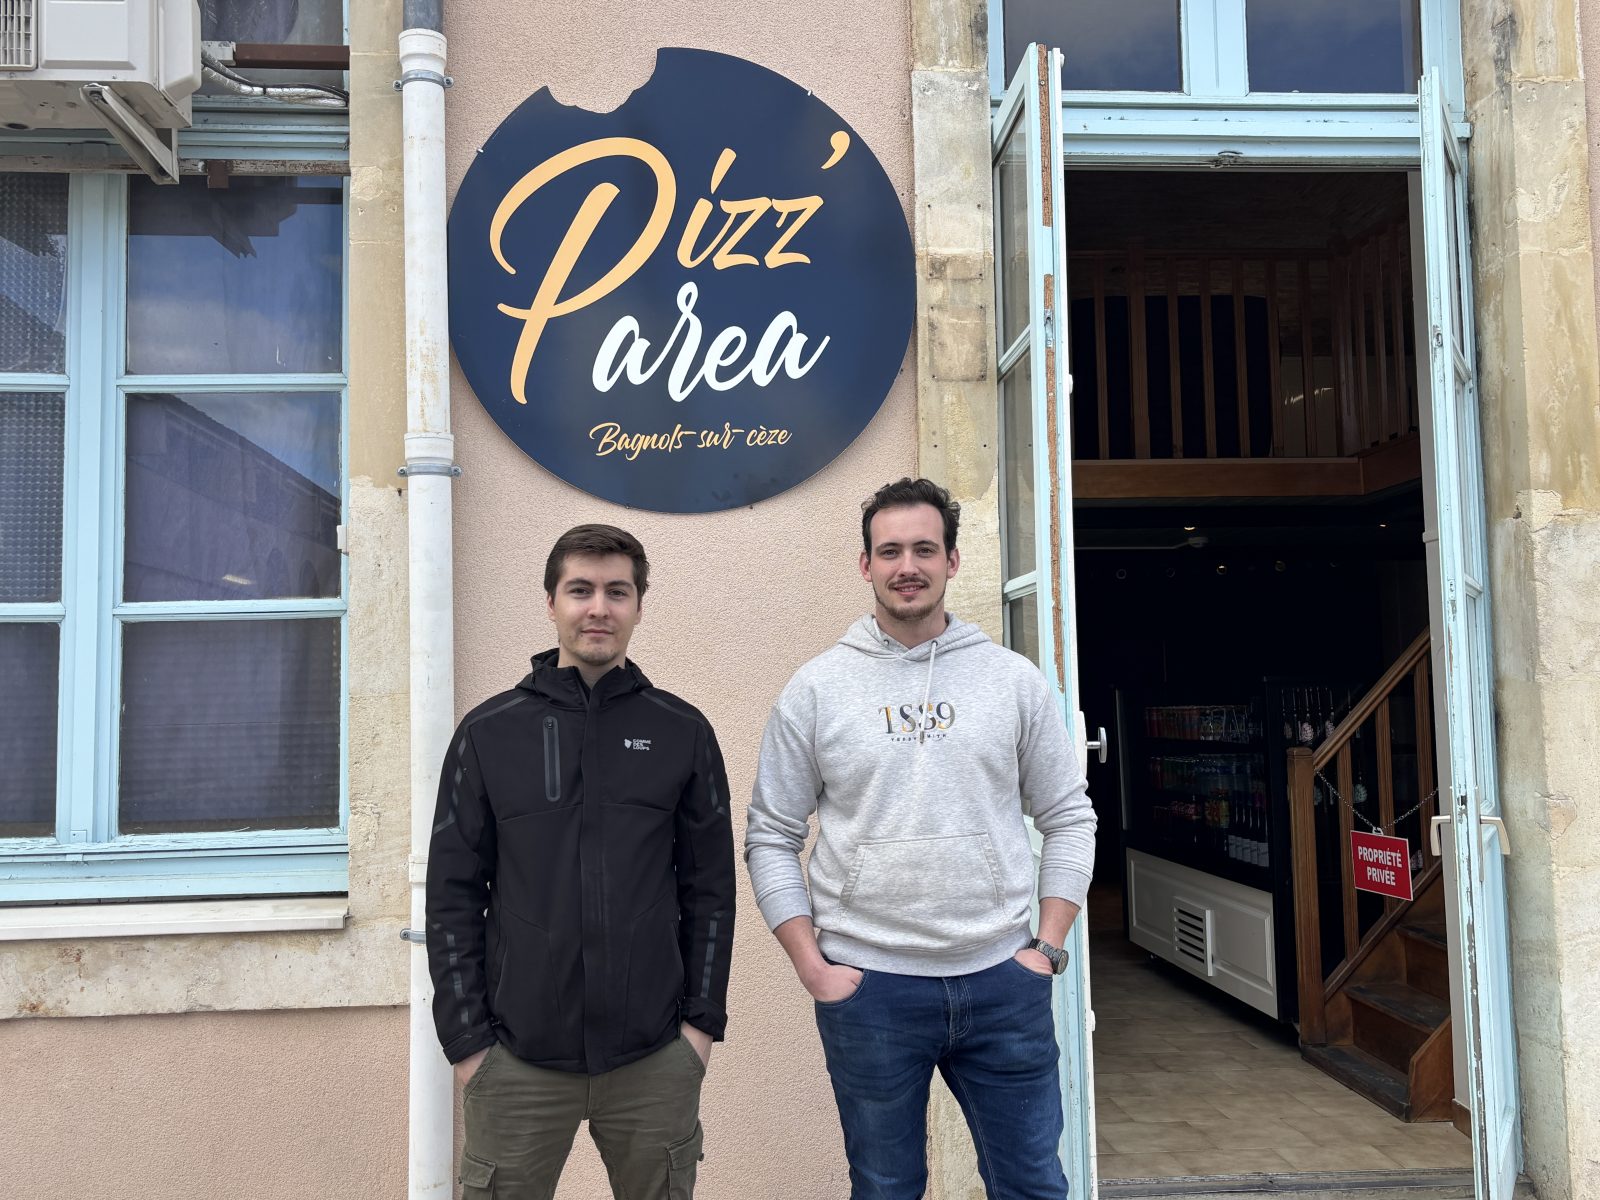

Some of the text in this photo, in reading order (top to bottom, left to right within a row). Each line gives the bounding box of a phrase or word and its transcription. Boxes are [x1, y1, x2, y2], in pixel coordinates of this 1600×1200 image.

[592, 281, 830, 402] area
[1358, 846, 1402, 868] PROPRIÉTÉ
[1367, 866, 1396, 886] PRIVÉE
